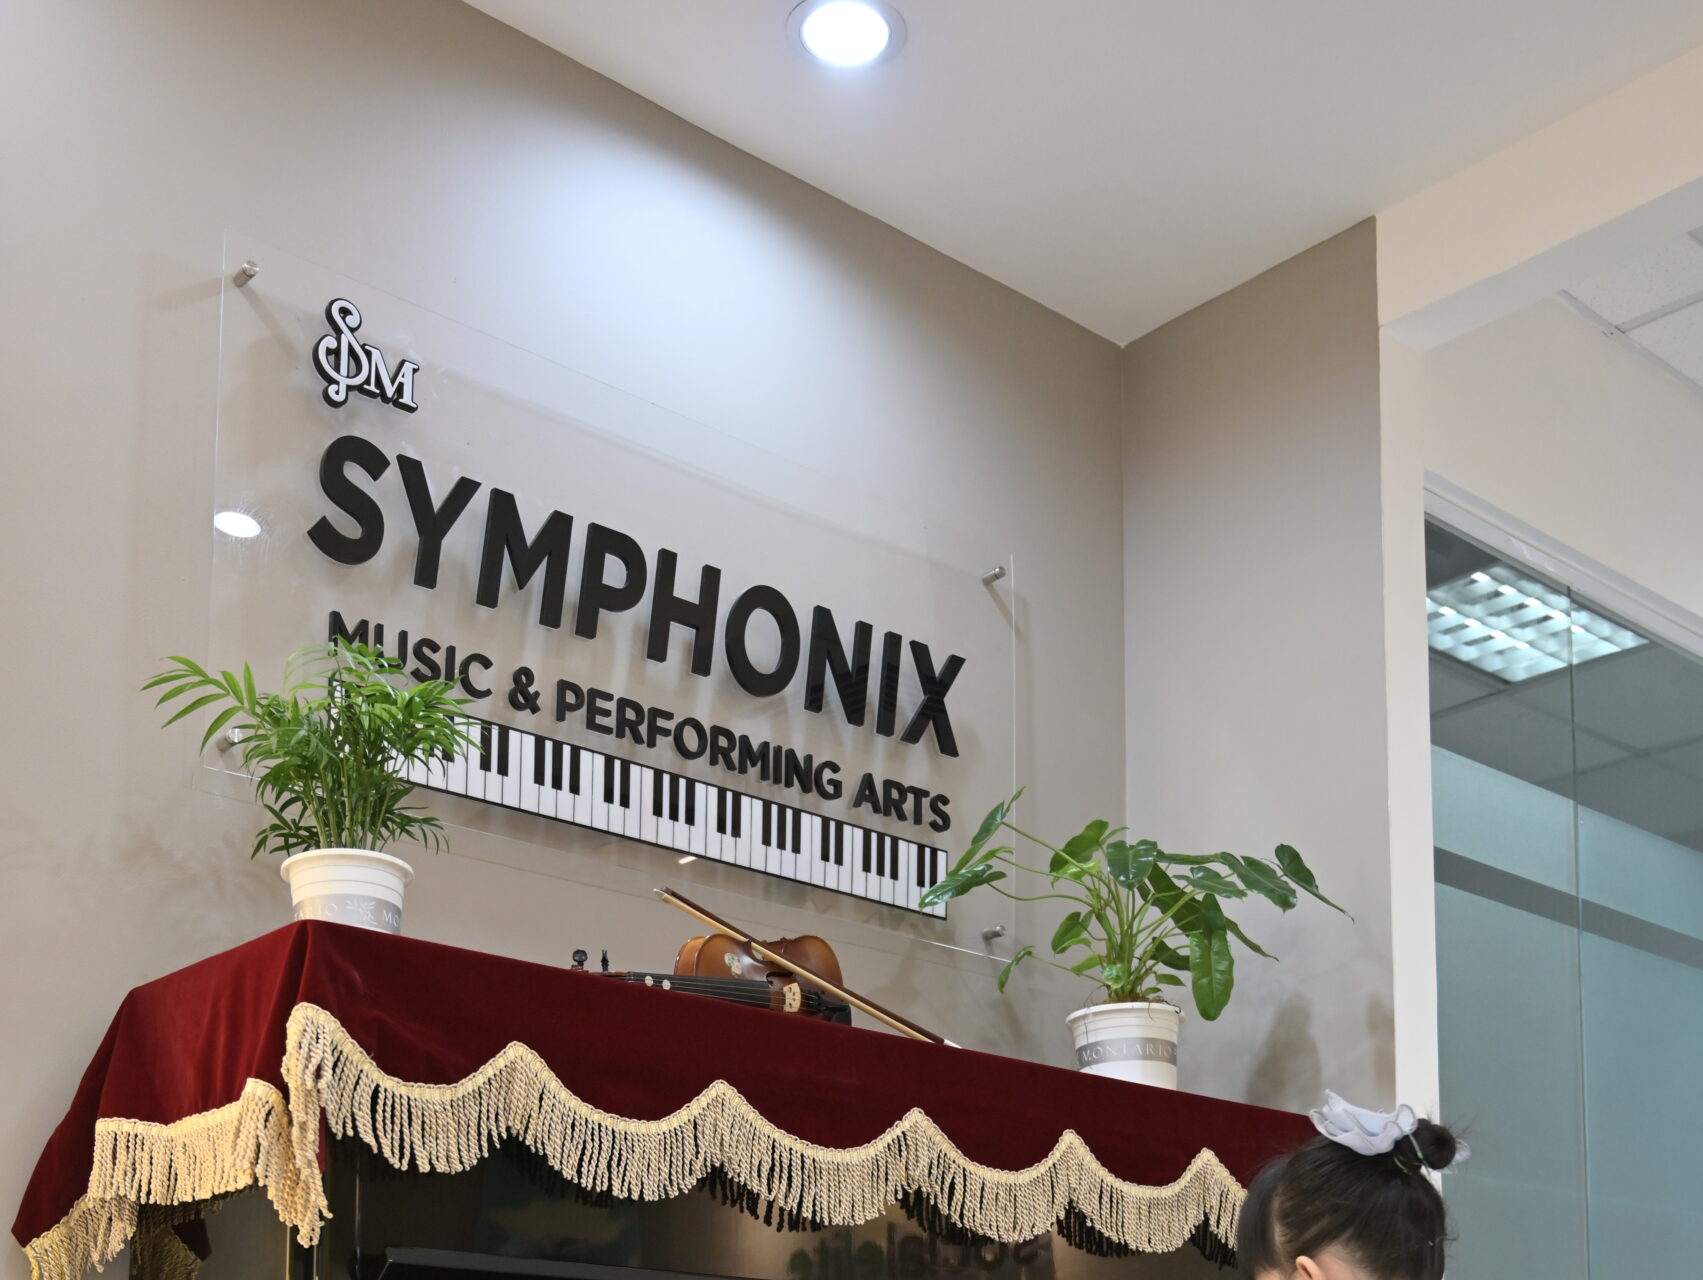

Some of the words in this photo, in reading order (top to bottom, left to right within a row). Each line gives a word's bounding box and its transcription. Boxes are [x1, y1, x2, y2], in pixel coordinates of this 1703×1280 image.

[306, 435, 967, 758] SYMPHONIX
[328, 610, 494, 700] MUSIC
[508, 666, 542, 715] &
[555, 679, 843, 801] PERFORMING
[852, 772, 952, 834] ARTS
